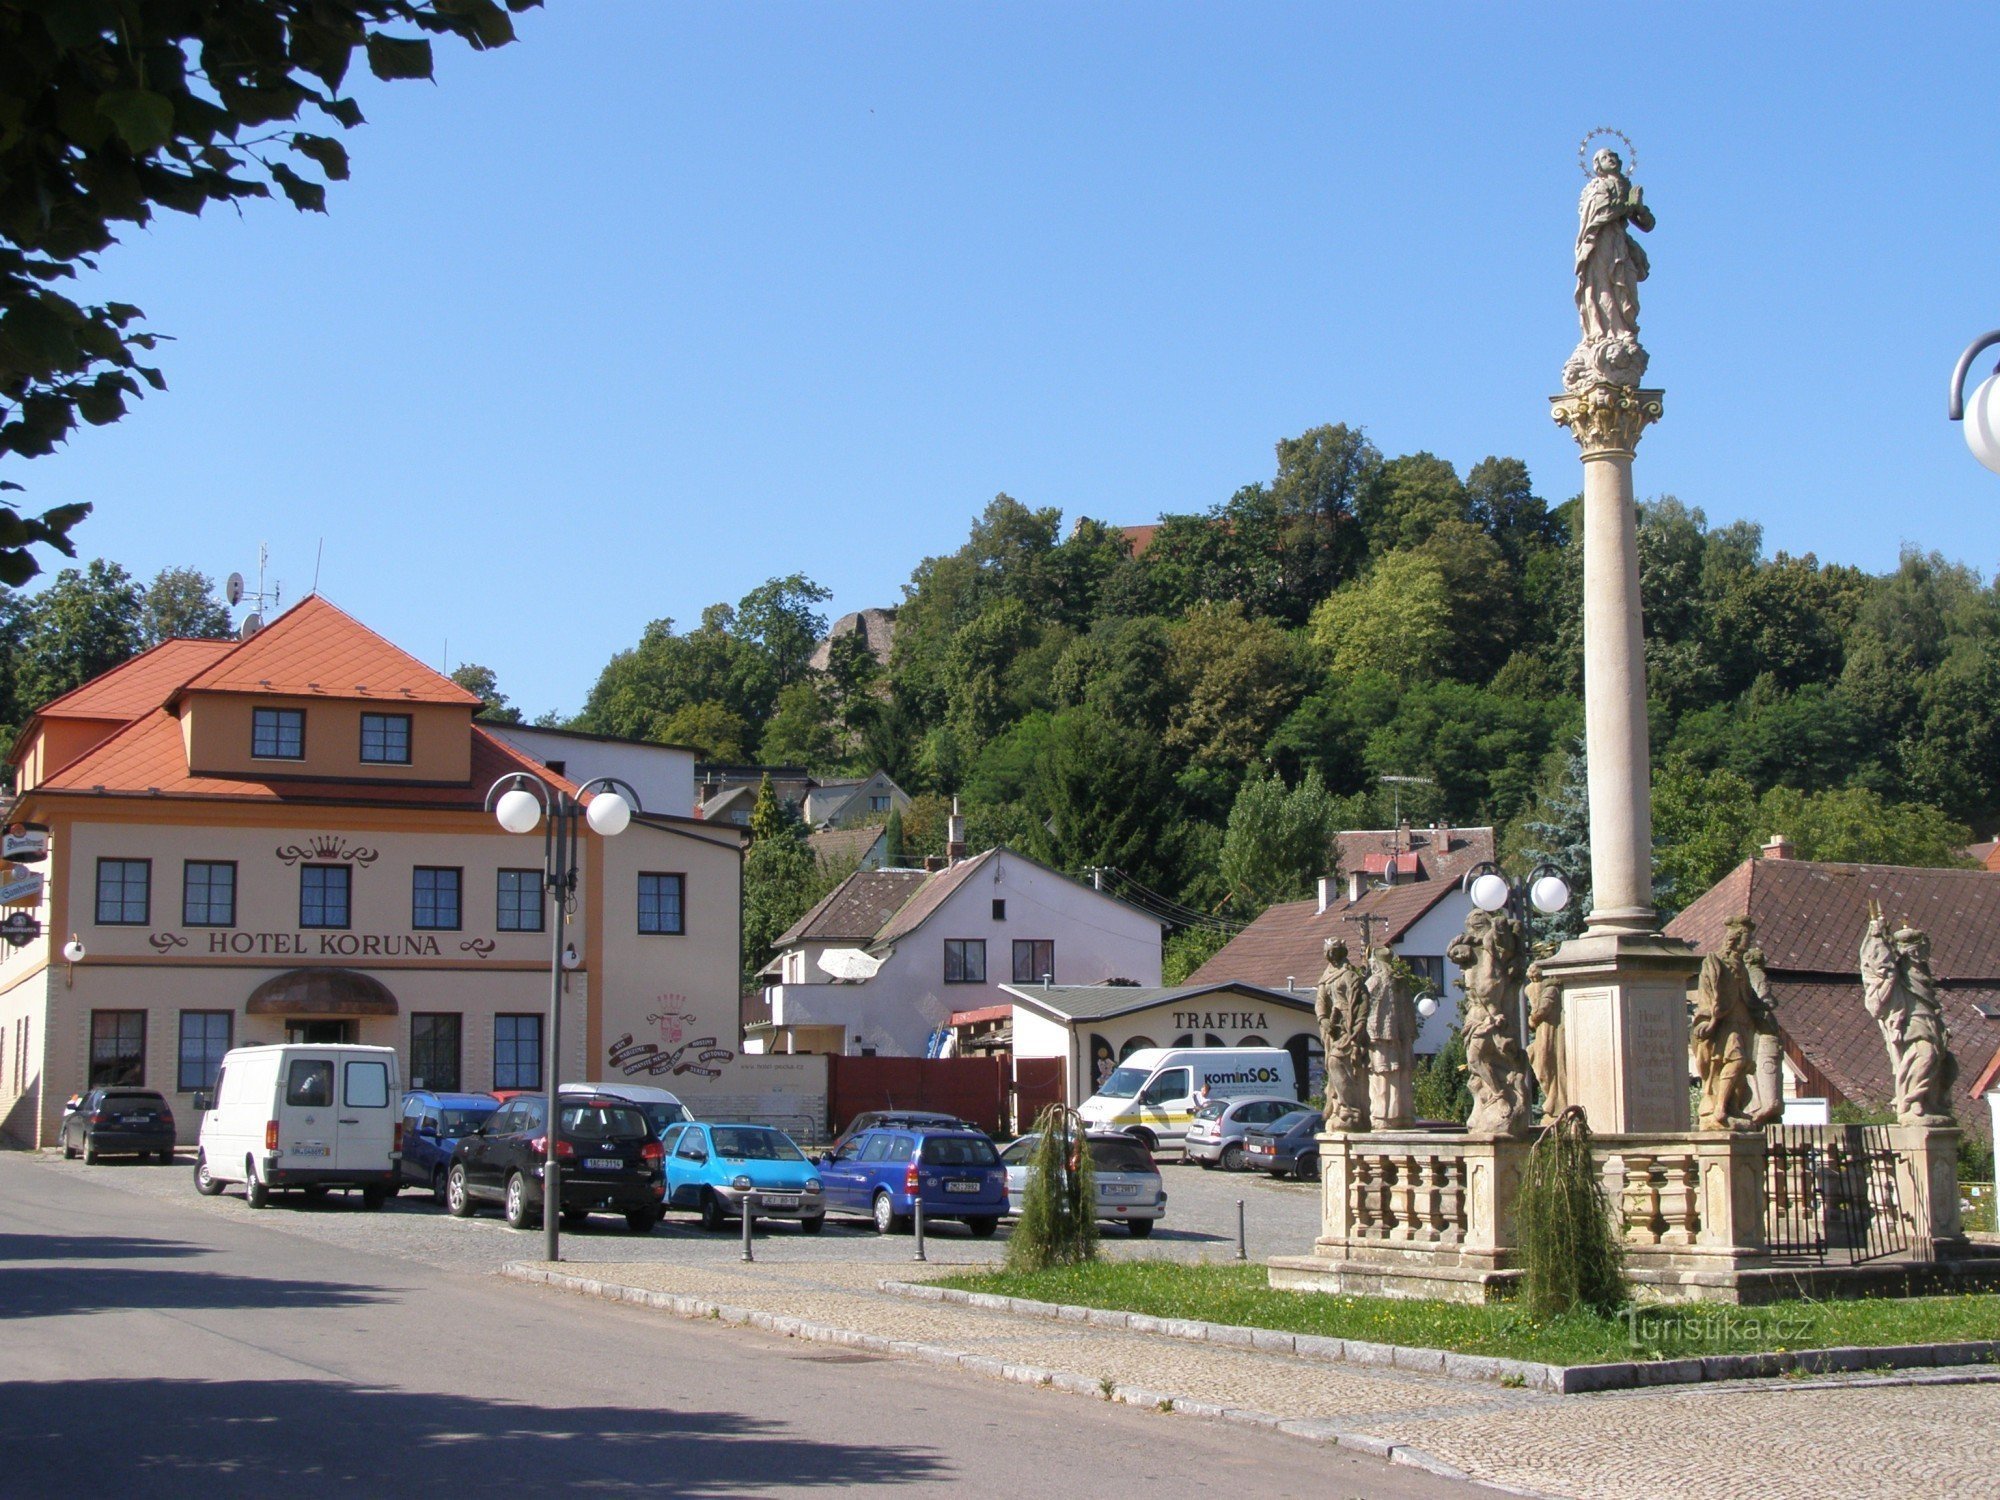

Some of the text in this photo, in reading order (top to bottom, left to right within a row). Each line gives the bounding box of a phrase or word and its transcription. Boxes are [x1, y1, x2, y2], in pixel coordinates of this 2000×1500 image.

[209, 932, 442, 956] HOTEL KORUNA
[1173, 1012, 1268, 1029] TRAFIKA
